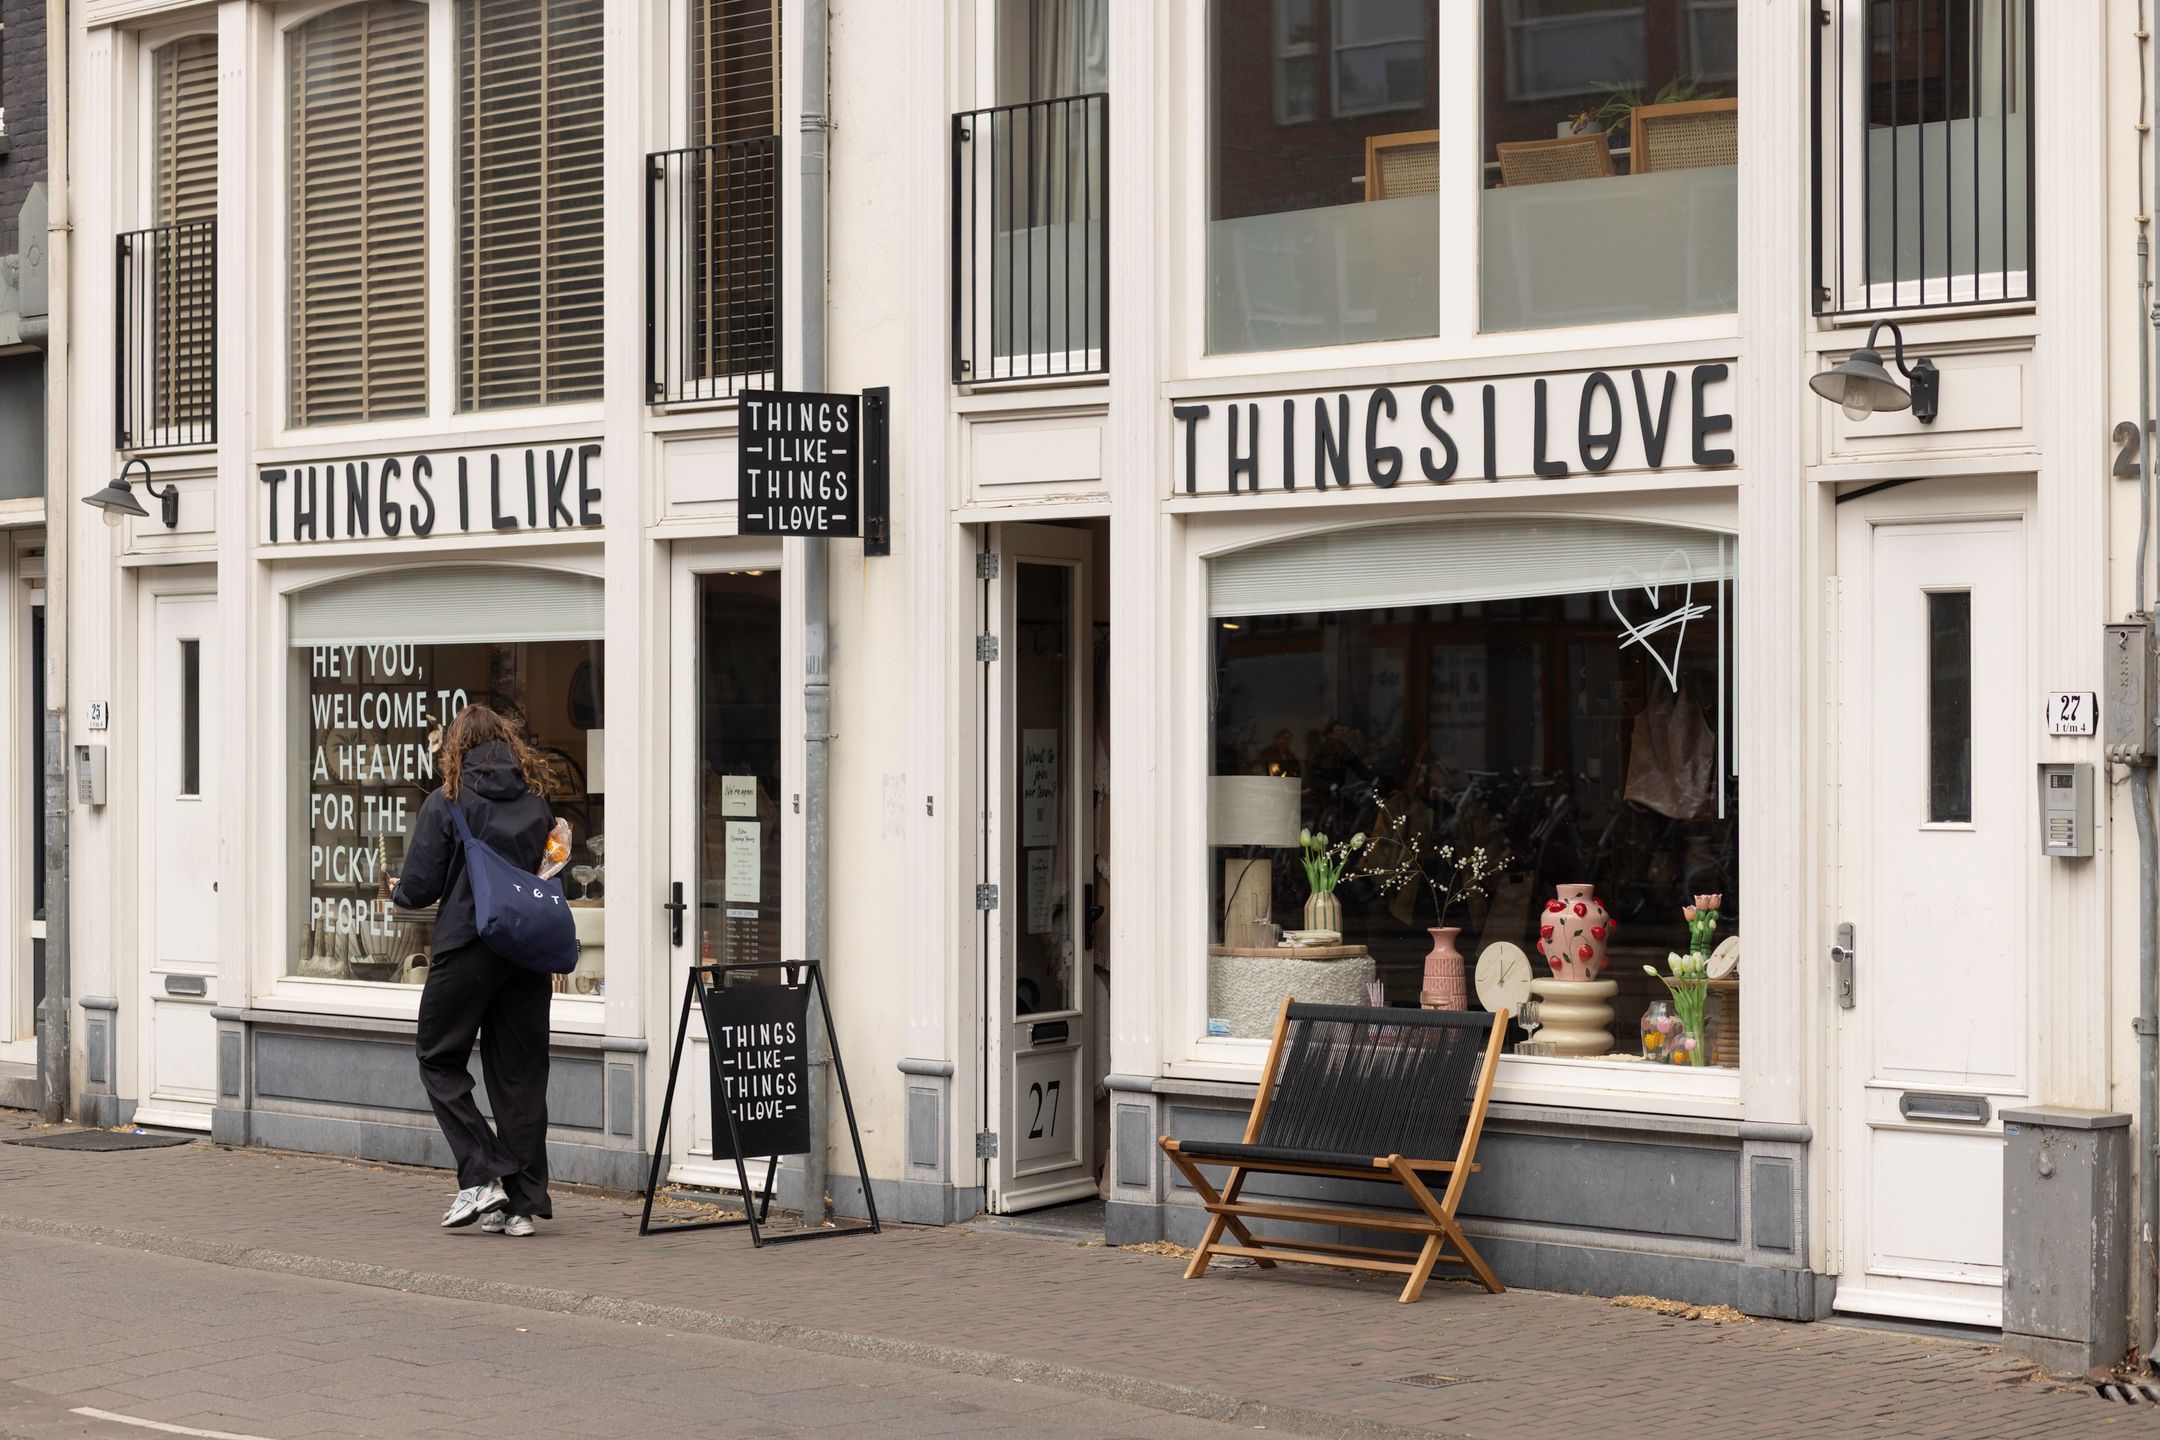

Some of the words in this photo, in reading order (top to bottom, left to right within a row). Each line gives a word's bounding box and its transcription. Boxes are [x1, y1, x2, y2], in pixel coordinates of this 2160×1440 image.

[747, 401, 849, 433] THINGS
[1173, 385, 1458, 493] THINGS
[1483, 384, 1496, 481] I
[1533, 364, 1735, 477] LOVE
[260, 455, 435, 543] THINGS
[458, 456, 469, 531] I
[490, 444, 602, 529] LIKE
[747, 469, 848, 501] THINGS
[313, 642, 356, 678] HEY
[367, 641, 423, 680] YOU,
[91, 703, 101, 720] 25
[312, 691, 428, 730] WELCOME
[437, 688, 468, 727] TO
[2060, 695, 2081, 721] 27
[2055, 723, 2059, 732] 1
[2062, 723, 2078, 732] t/m
[2080, 723, 2086, 732] 4
[312, 745, 329, 781] A
[339, 744, 433, 781] HEAVEN
[311, 793, 354, 831] FOR
[364, 795, 406, 832] THE
[311, 845, 379, 883] PICKY
[311, 896, 402, 938] PEOPLE.
[722, 1022, 796, 1048] THINGS
[724, 1072, 797, 1098] THINGS
[1028, 1080, 1061, 1139] 27
